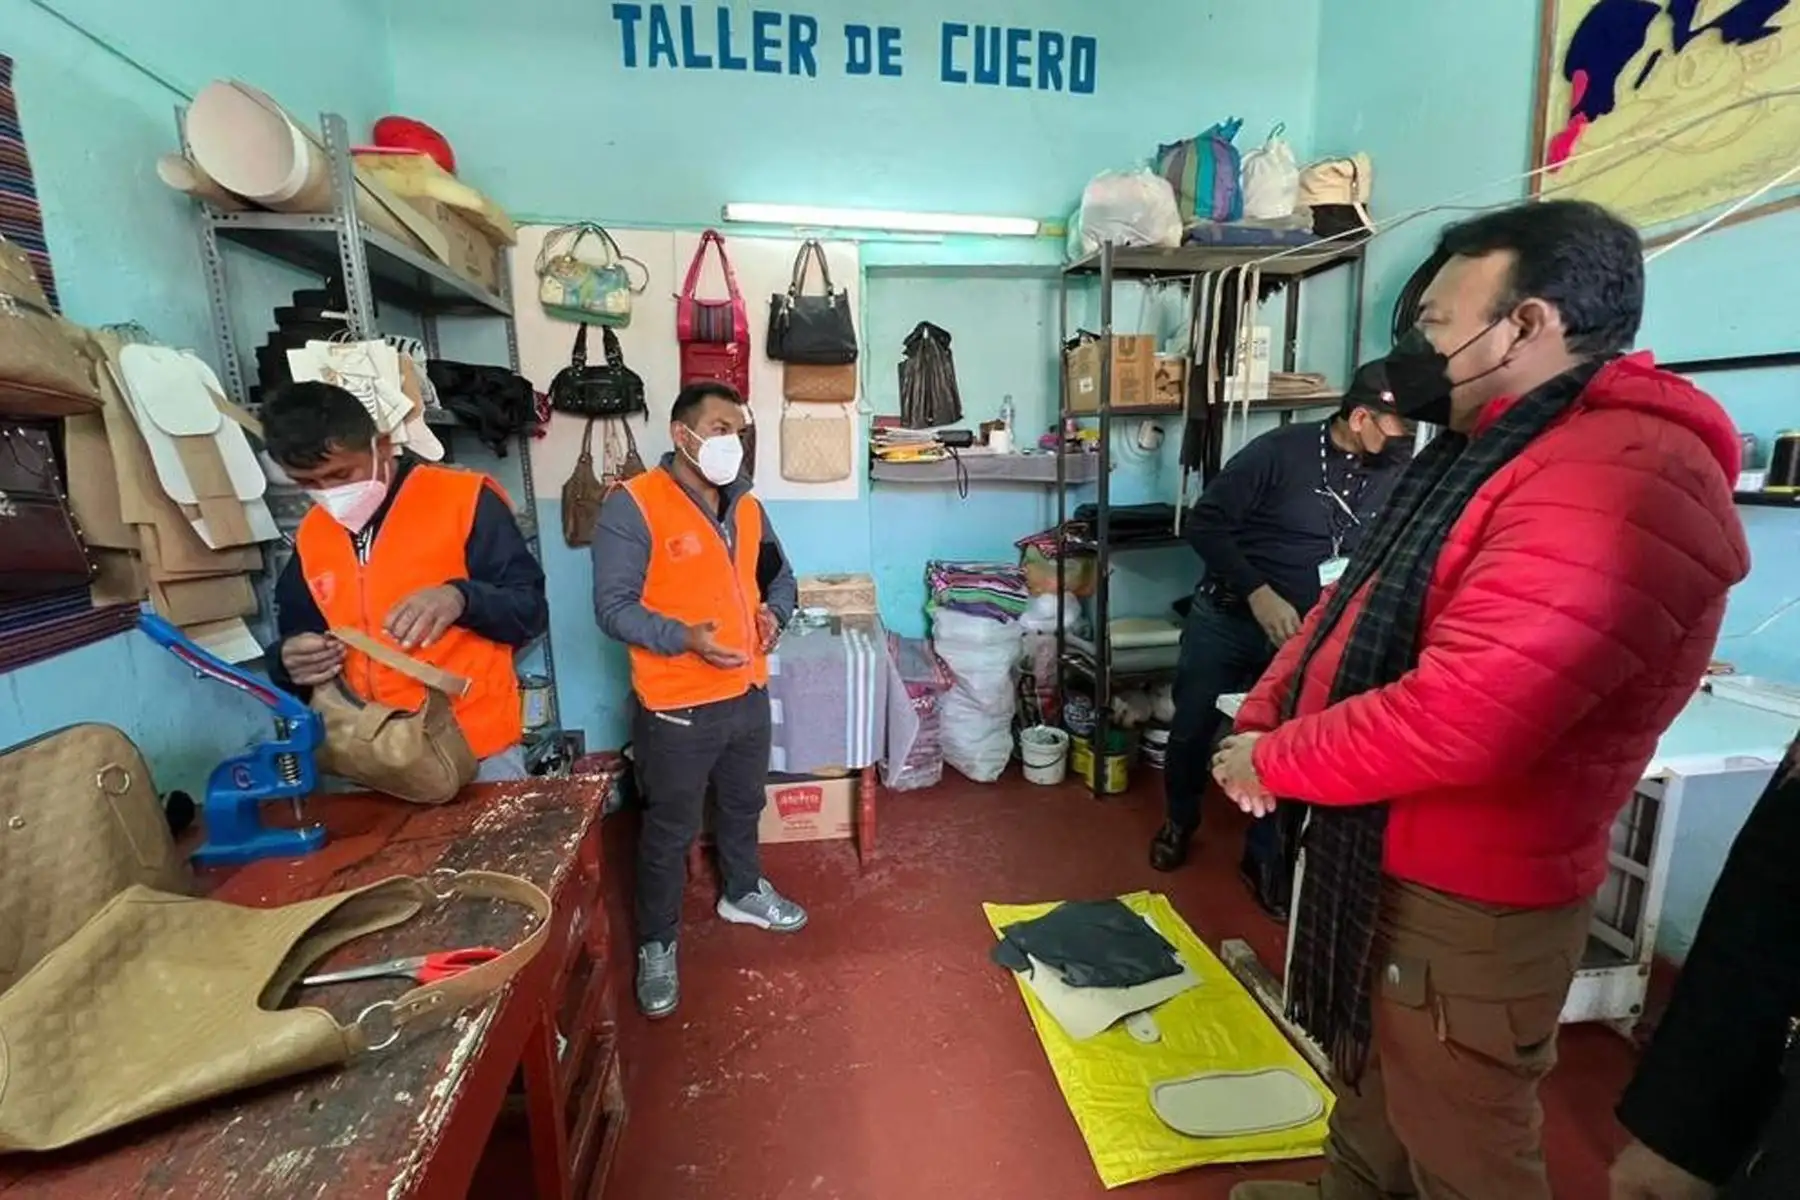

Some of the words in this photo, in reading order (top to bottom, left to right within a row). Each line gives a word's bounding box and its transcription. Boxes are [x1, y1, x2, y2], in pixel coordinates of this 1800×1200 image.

[612, 3, 818, 78] TALLER
[844, 24, 903, 76] DE
[941, 22, 1097, 94] CUERO
